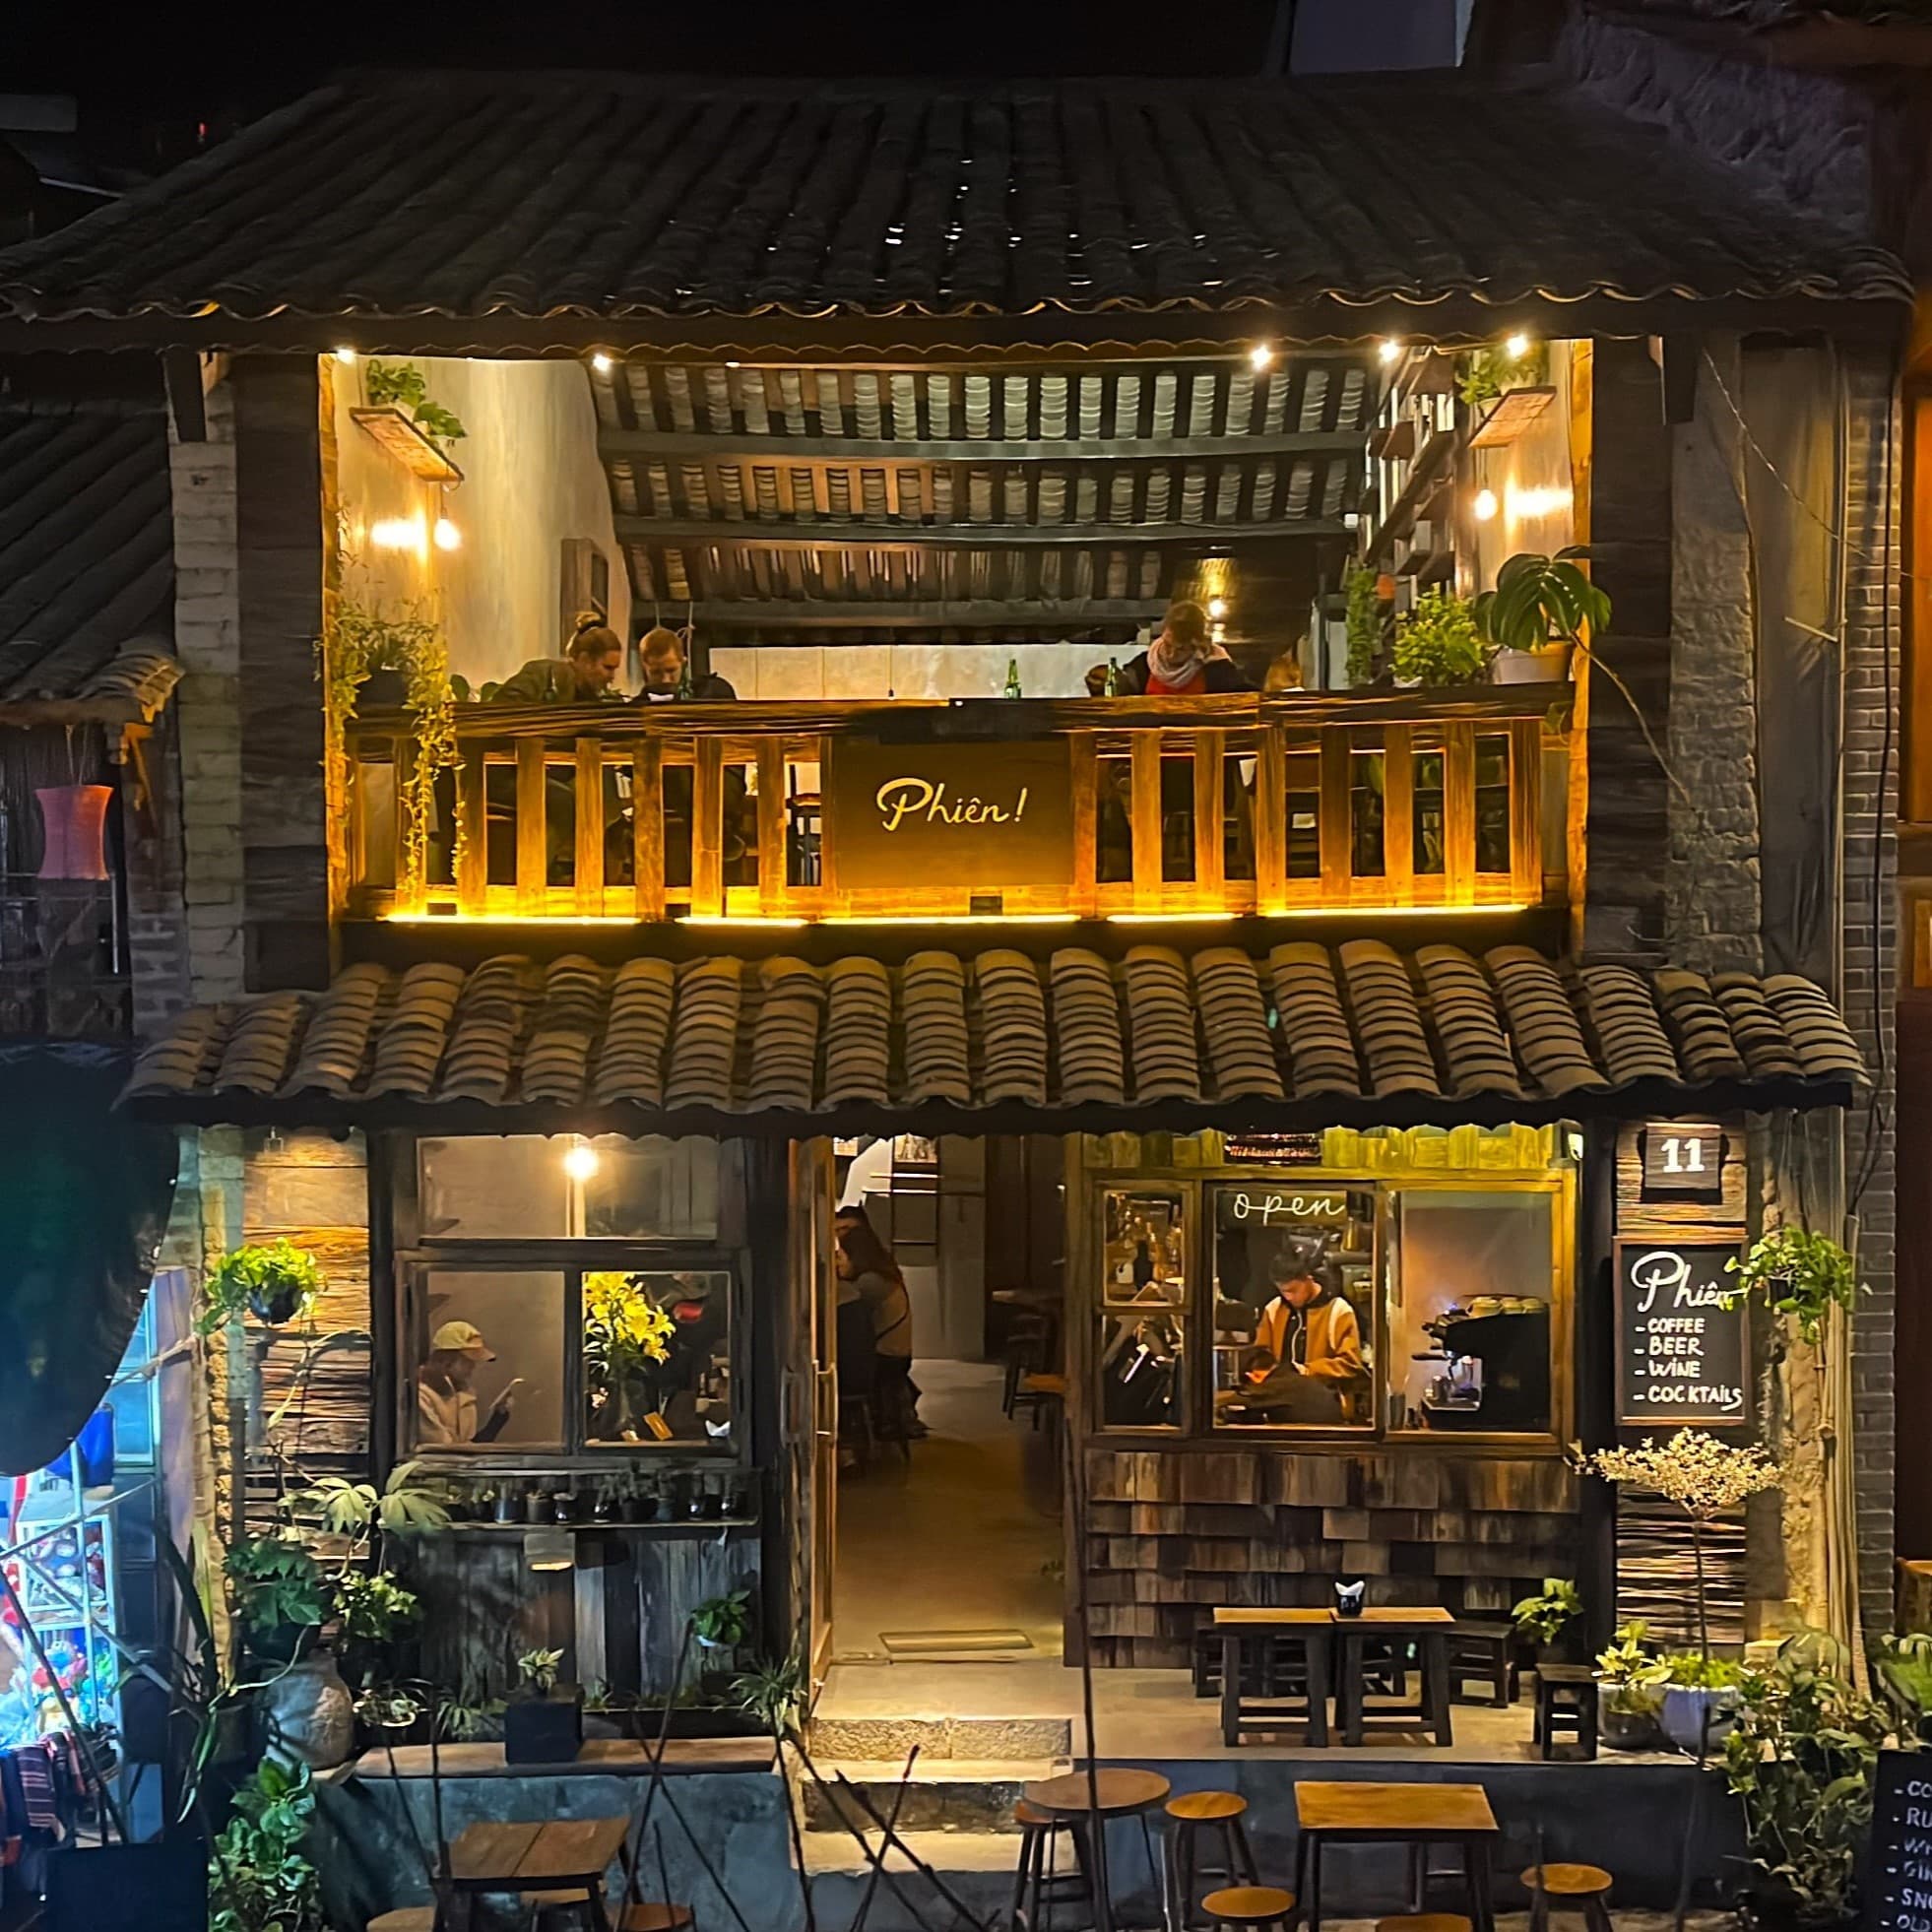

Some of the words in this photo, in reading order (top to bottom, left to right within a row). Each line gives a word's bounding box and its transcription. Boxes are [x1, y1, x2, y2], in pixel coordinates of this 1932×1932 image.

[876, 776, 1027, 831] Phiên!
[1660, 1137, 1706, 1173] 11
[1646, 1318, 1706, 1334] COFFEE
[1648, 1335, 1706, 1357] BEER
